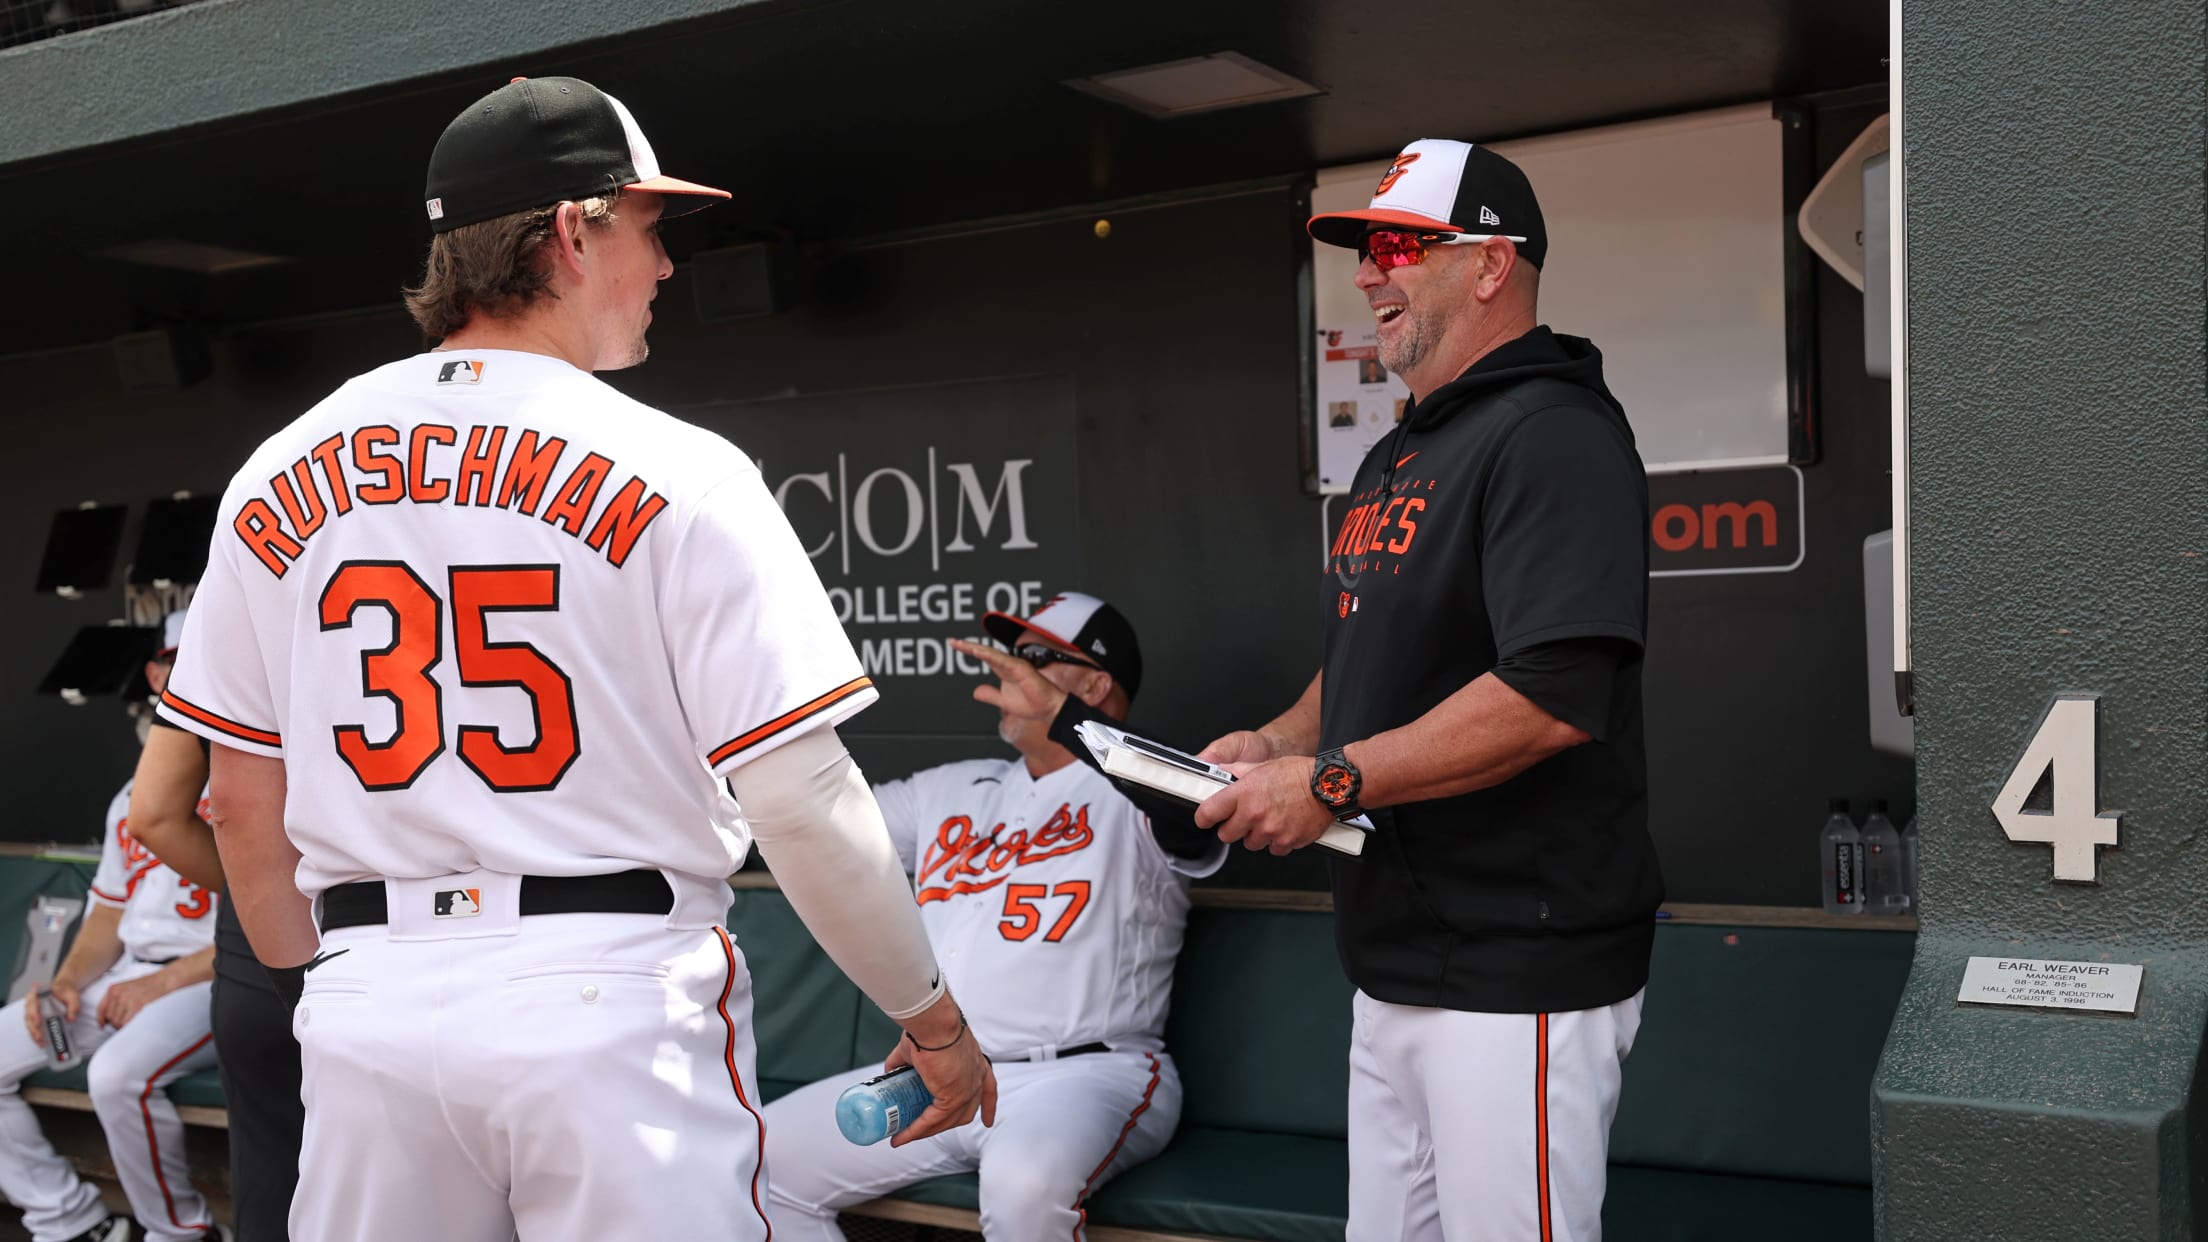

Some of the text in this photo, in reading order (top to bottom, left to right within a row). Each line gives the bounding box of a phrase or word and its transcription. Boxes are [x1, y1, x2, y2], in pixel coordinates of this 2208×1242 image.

[233, 423, 669, 580] RUTSCHMAN
[827, 581, 1042, 623] OLLEGE OF
[318, 560, 581, 793] 35
[1991, 697, 2120, 881] 4
[998, 880, 1091, 942] 57
[1982, 985, 2007, 993] HALL
[2029, 988, 2056, 996] FAME
[2059, 990, 2115, 999] INDUCTION
[1998, 961, 2110, 976] EARL WEAVER
[2026, 973, 2076, 981] MANAGER
